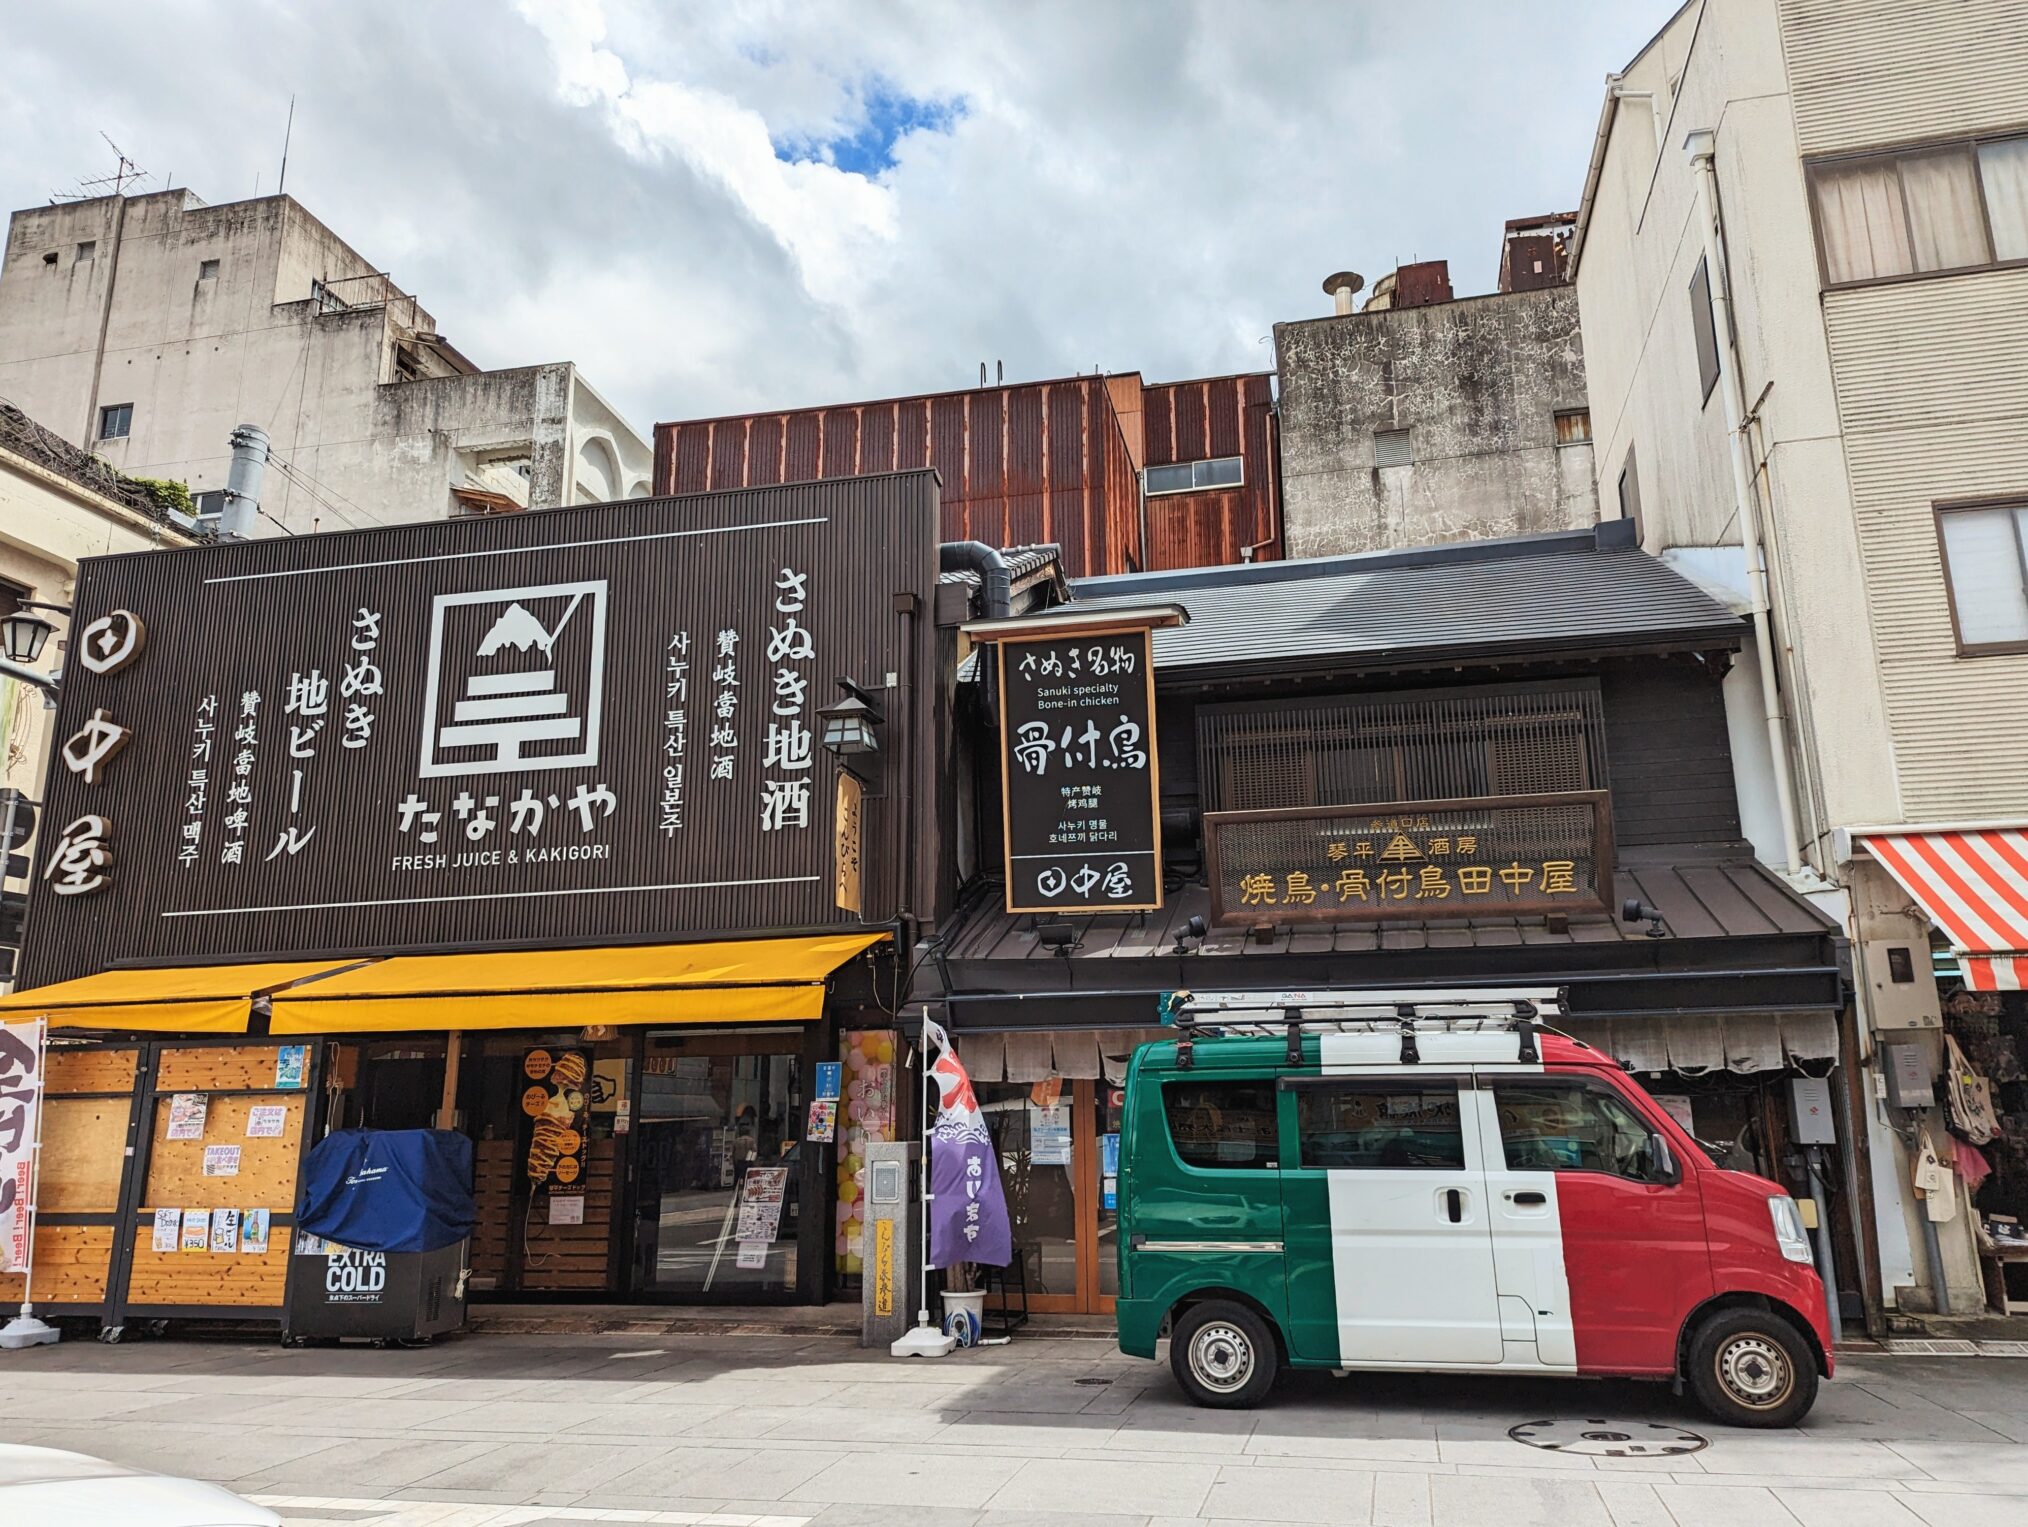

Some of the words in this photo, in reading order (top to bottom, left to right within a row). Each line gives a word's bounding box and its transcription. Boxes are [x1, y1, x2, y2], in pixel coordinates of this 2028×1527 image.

[340, 608, 384, 749] さぬき
[667, 632, 691, 702] 사누키
[1018, 646, 1136, 682] さぬき名物
[760, 568, 815, 831] さぬき地酒
[1037, 686, 1072, 697] Sanuki
[1073, 683, 1119, 696] specialty
[1037, 698, 1078, 710] Bone-in
[1080, 695, 1120, 707] chicken
[192, 695, 219, 762] 사누키
[663, 710, 688, 757] 특산
[1013, 715, 1147, 775] 骨付鳥
[44, 609, 142, 895] 田中屋
[265, 669, 329, 861] 地ビール
[185, 769, 209, 814] 특산
[659, 765, 684, 838] 일본주
[398, 783, 617, 844] たなかや
[1058, 820, 1086, 830] 사누키
[178, 821, 202, 868] 맥주
[1089, 831, 1118, 842] 닭다리
[1327, 841, 1376, 862] 琴平
[1428, 836, 1478, 855] 酒房
[392, 854, 447, 871] FRESH
[452, 850, 502, 868] JUICE
[507, 850, 519, 864] &
[526, 844, 610, 863] KAKIGORI
[1037, 861, 1133, 899] 田中屋
[206, 1147, 240, 1156] TAKEOUT
[184, 1239, 205, 1249] ¥350
[327, 1249, 387, 1268] EXTRA
[325, 1266, 386, 1292] COLD
